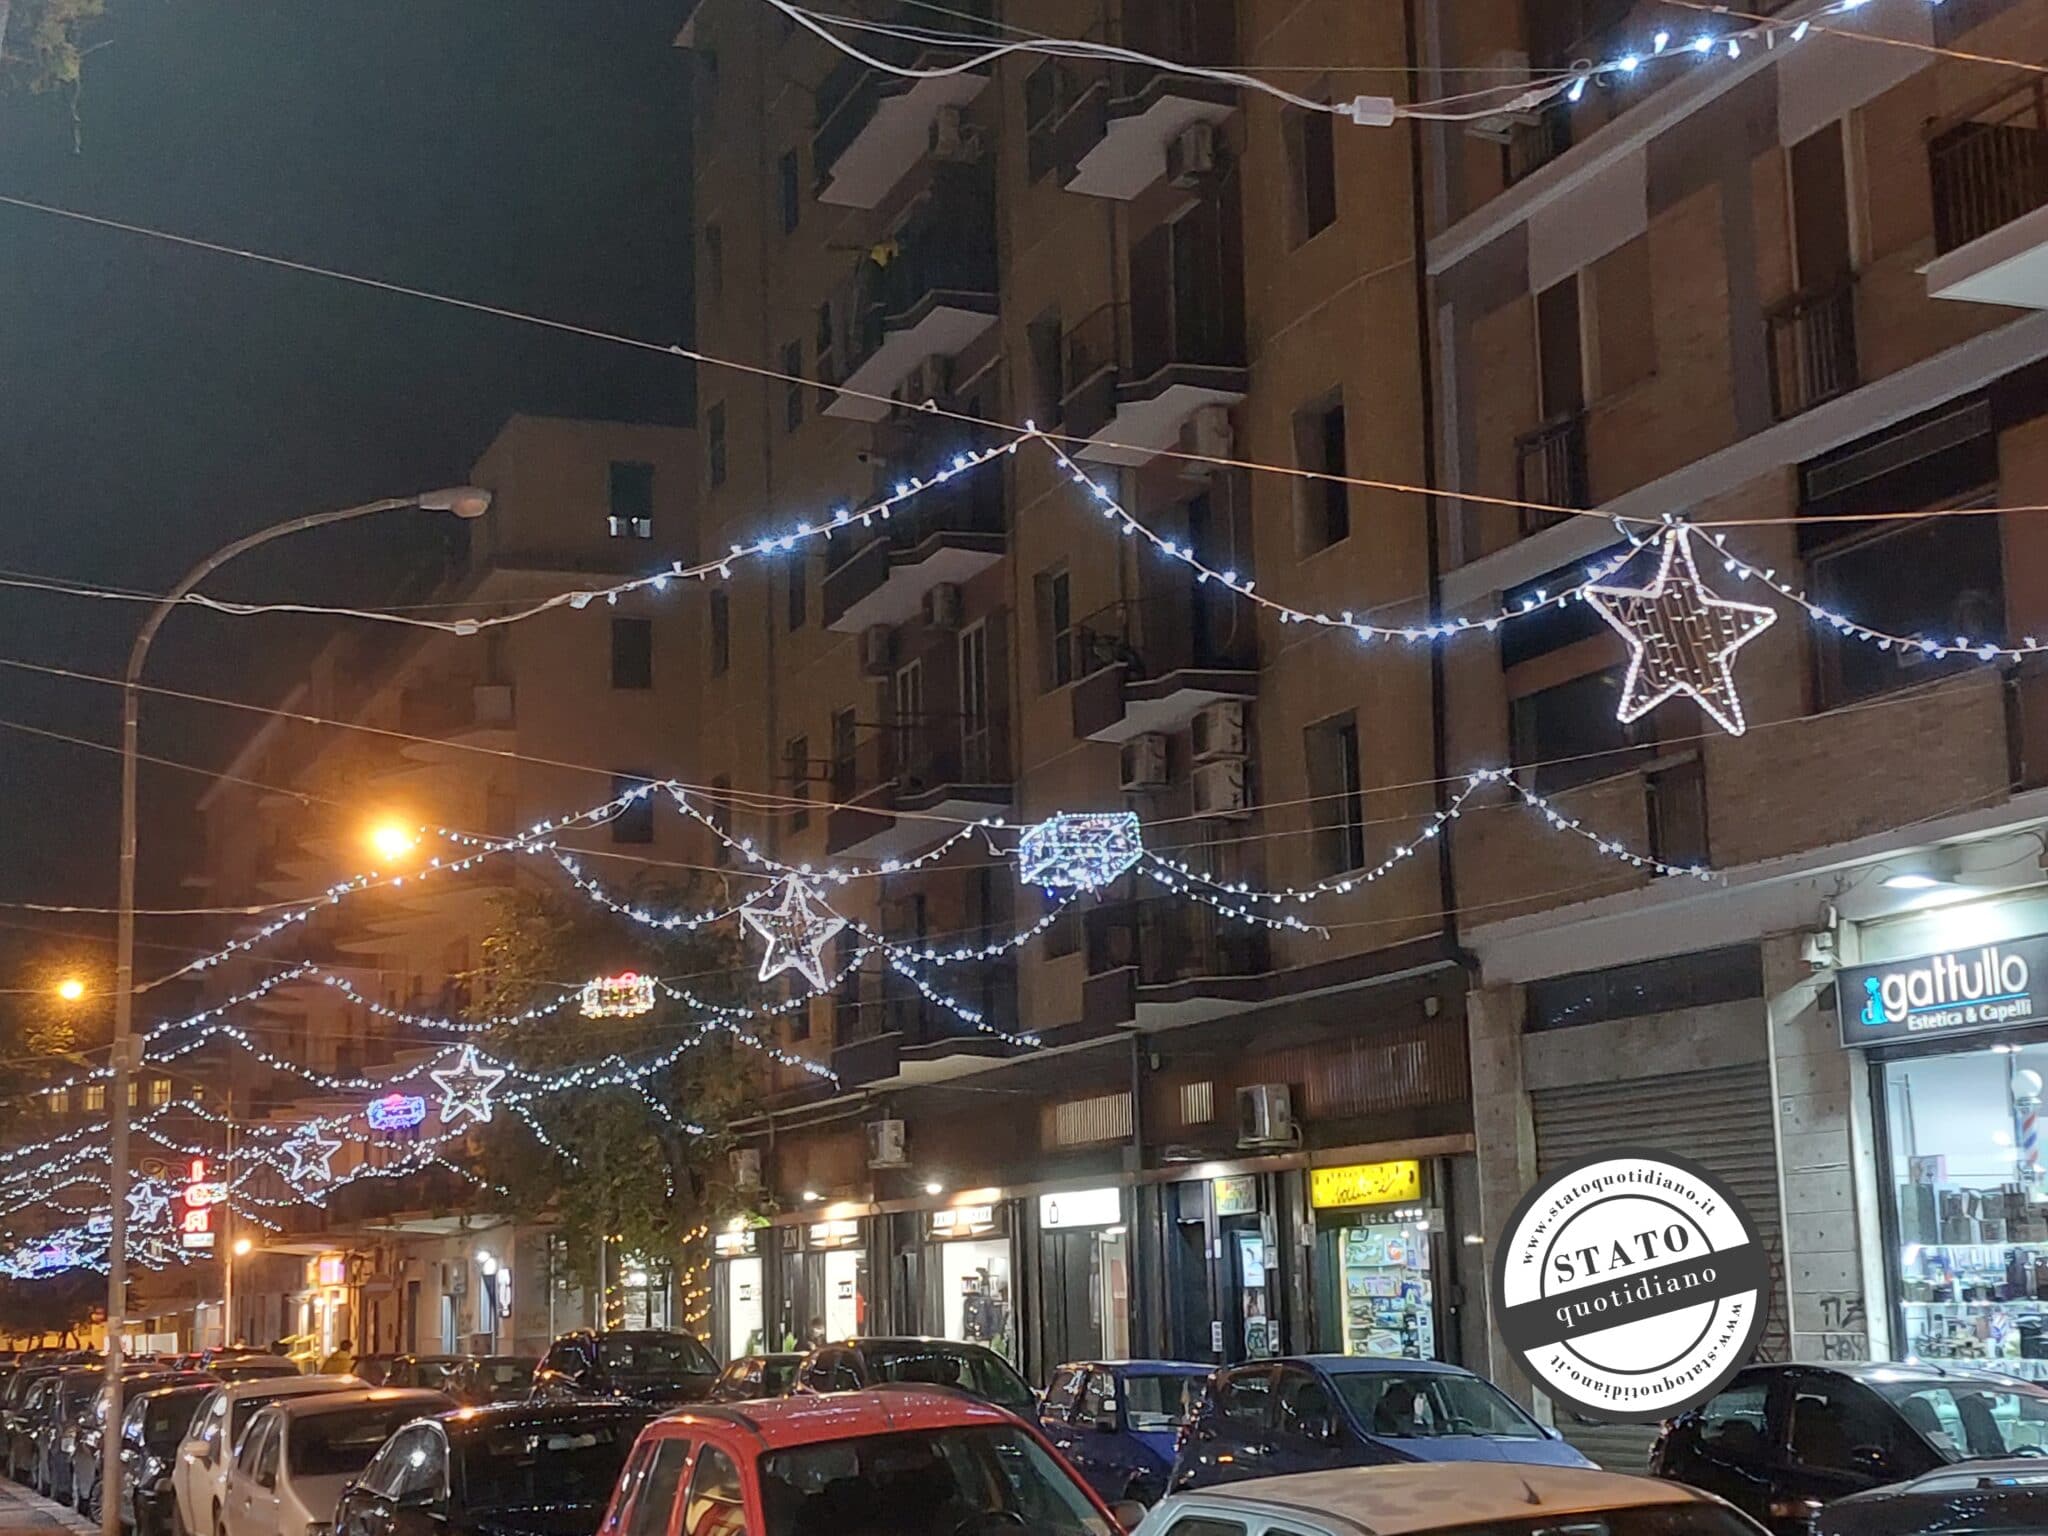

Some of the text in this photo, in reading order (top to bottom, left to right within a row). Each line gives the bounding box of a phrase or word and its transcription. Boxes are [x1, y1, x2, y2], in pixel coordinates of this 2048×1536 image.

[1907, 999, 2032, 1031] Estetica & Capelli
